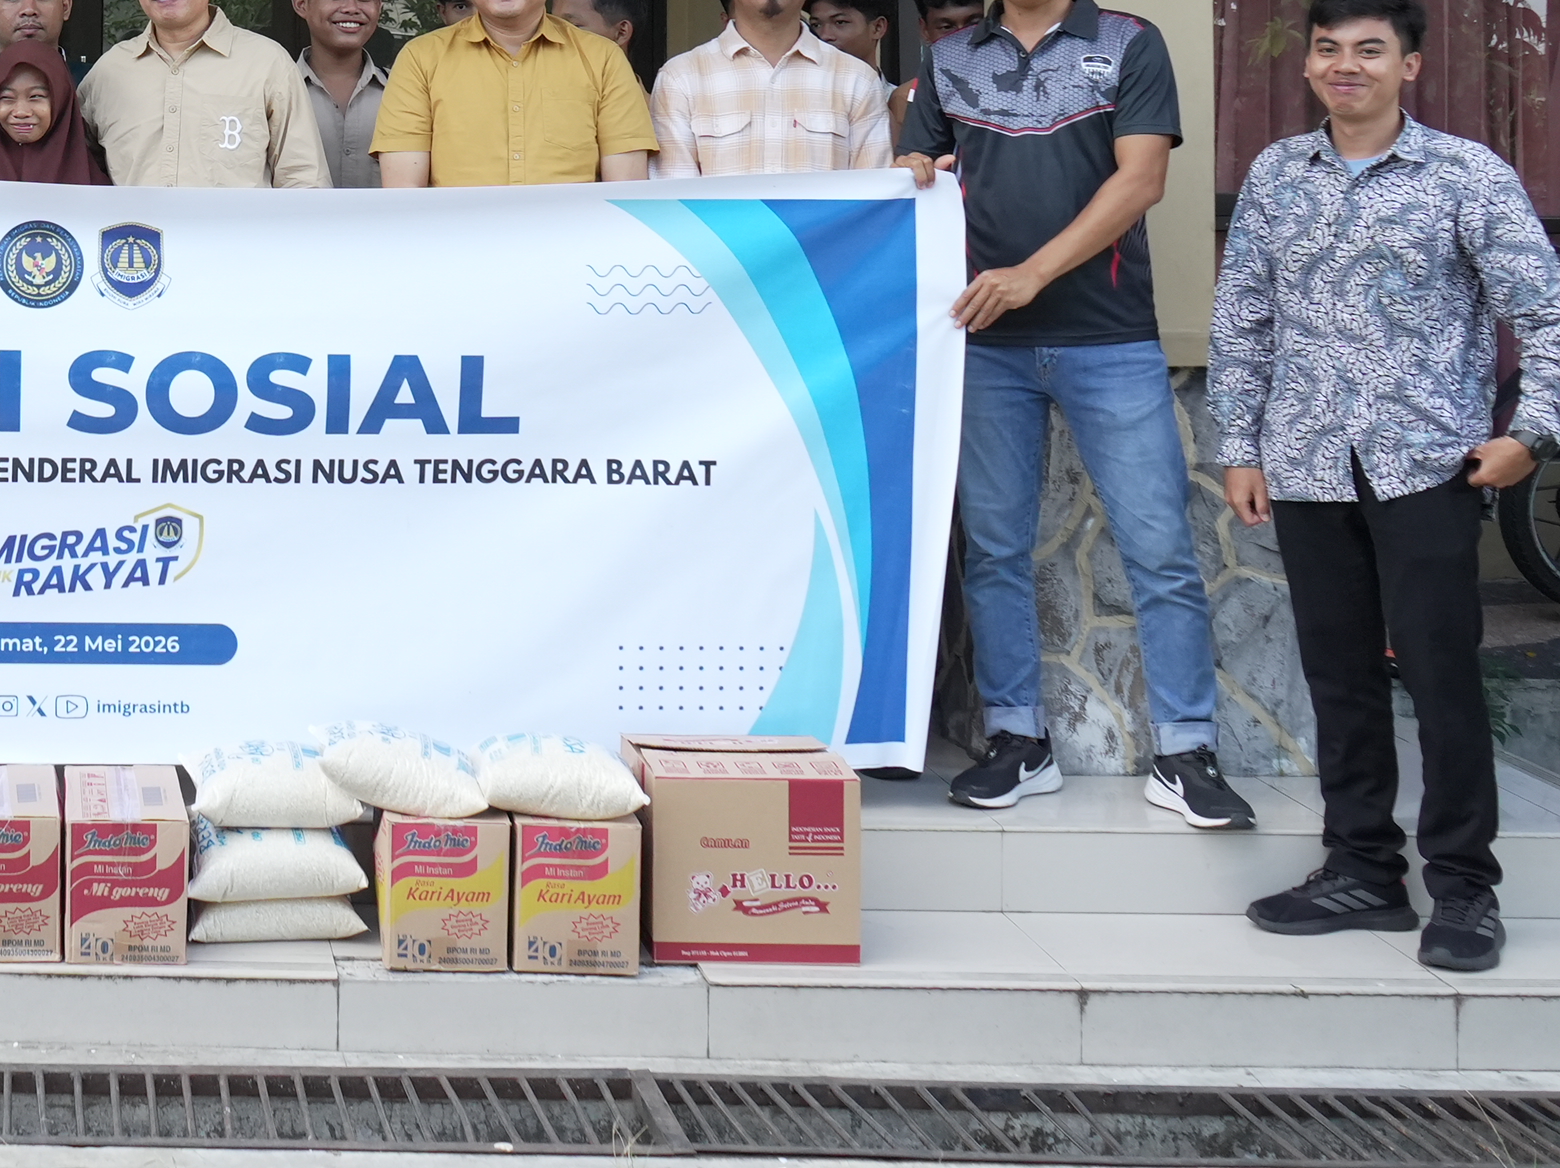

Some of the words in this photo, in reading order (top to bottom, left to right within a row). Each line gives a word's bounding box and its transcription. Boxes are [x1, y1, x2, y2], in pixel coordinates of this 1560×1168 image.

[219, 116, 242, 149] B
[115, 271, 148, 281] IMIGRASI
[8, 288, 36, 306] REPUBLIK
[37, 290, 70, 306] INDONESIA
[66, 350, 521, 436] SOSIAL
[152, 458, 301, 484] IMIGRASI
[312, 459, 405, 485] NUSA
[414, 458, 597, 485] TENGGARA
[607, 459, 718, 487] BARAT
[12, 556, 179, 597] RAKYAT
[54, 635, 78, 652] 22
[84, 635, 123, 652] Mei
[128, 636, 180, 653] 2026
[97, 699, 190, 718] imigrasintb
[75, 829, 150, 855] Indomie
[395, 829, 470, 855] Indomie
[525, 832, 602, 857] Indomie
[94, 865, 105, 873] Mi
[415, 865, 425, 874] Mi
[426, 865, 453, 875] Instan
[545, 867, 556, 876] Mi
[557, 867, 584, 877] Instan
[84, 883, 111, 896] Mi
[111, 886, 170, 901] goreng
[415, 879, 435, 887] Rasa
[406, 887, 443, 901] Kari
[443, 889, 491, 906] Ayam
[537, 889, 574, 904] Kari
[574, 891, 622, 909] Ayam
[2, 939, 24, 947] BPOM
[34, 939, 45, 947] MD
[447, 946, 468, 954] BPOM
[577, 949, 599, 957] BPOM
